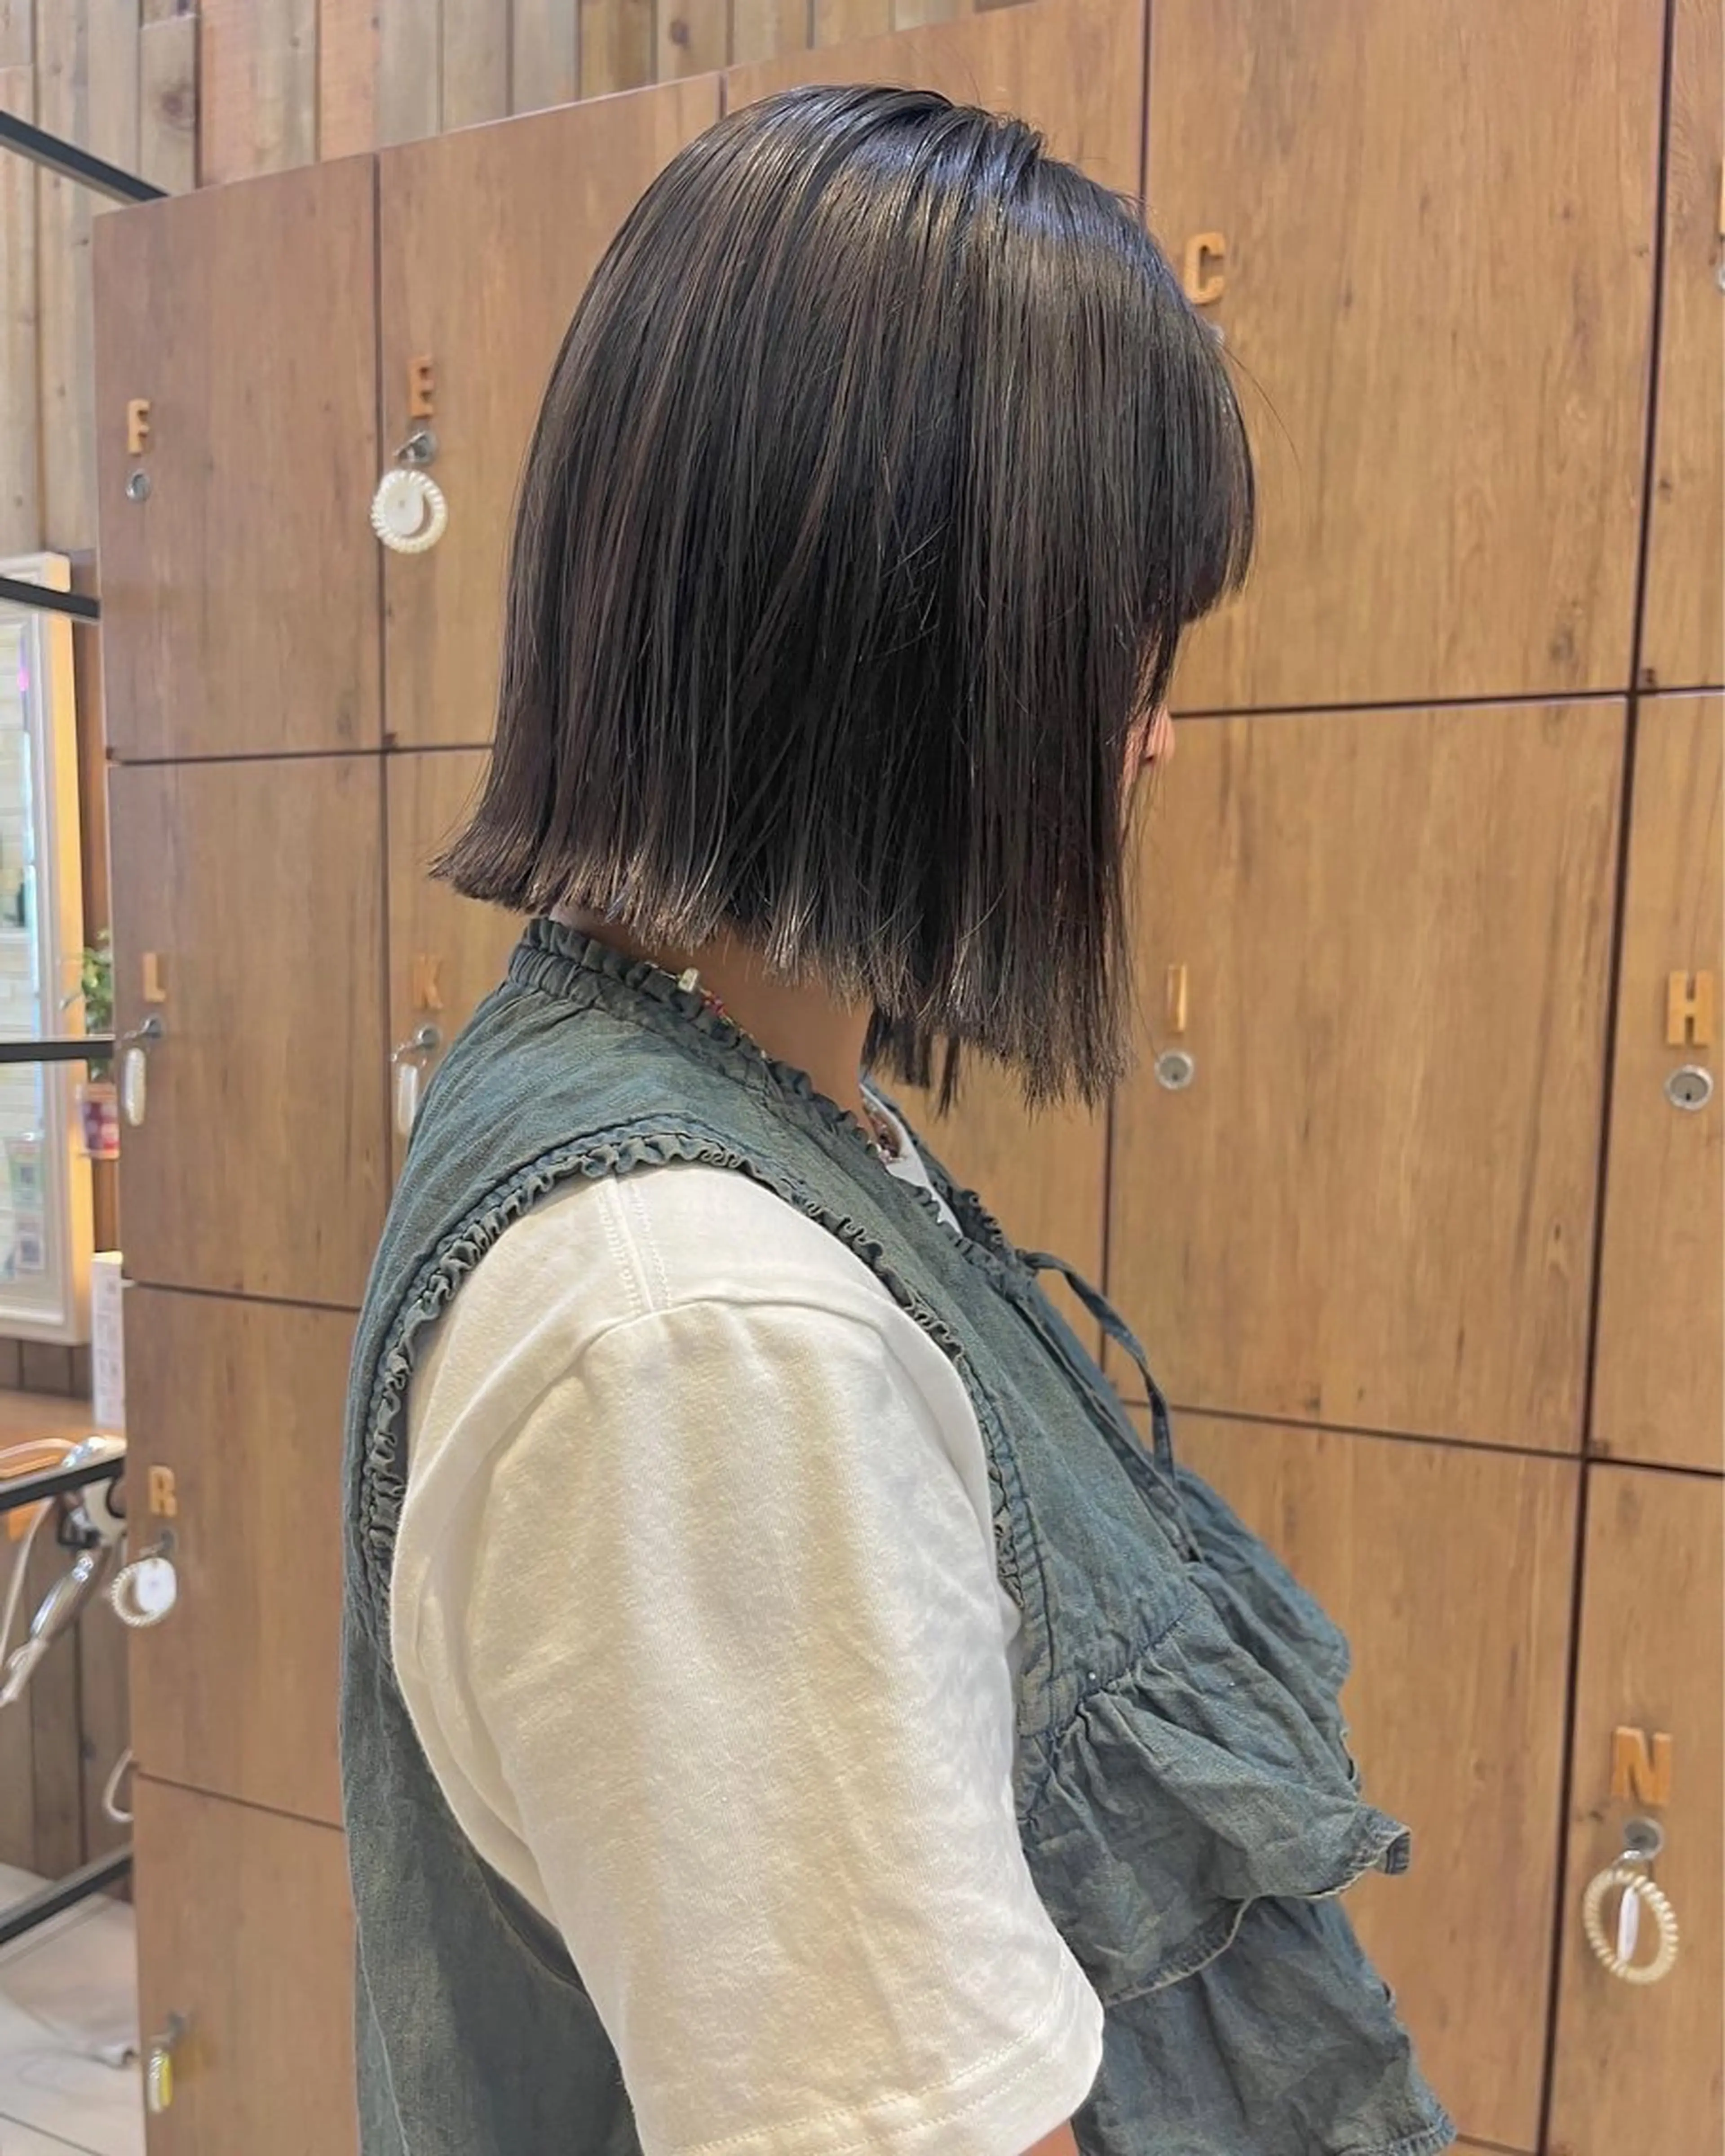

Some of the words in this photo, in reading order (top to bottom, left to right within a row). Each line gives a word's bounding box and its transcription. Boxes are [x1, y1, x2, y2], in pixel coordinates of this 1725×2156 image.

[1184, 232, 1225, 304] C
[409, 354, 434, 417] E
[128, 399, 150, 454] F
[142, 952, 166, 1002] L
[414, 957, 442, 1009] K
[1667, 970, 1714, 1045] H
[149, 1465, 177, 1517] R
[1612, 1726, 1673, 1805] N
